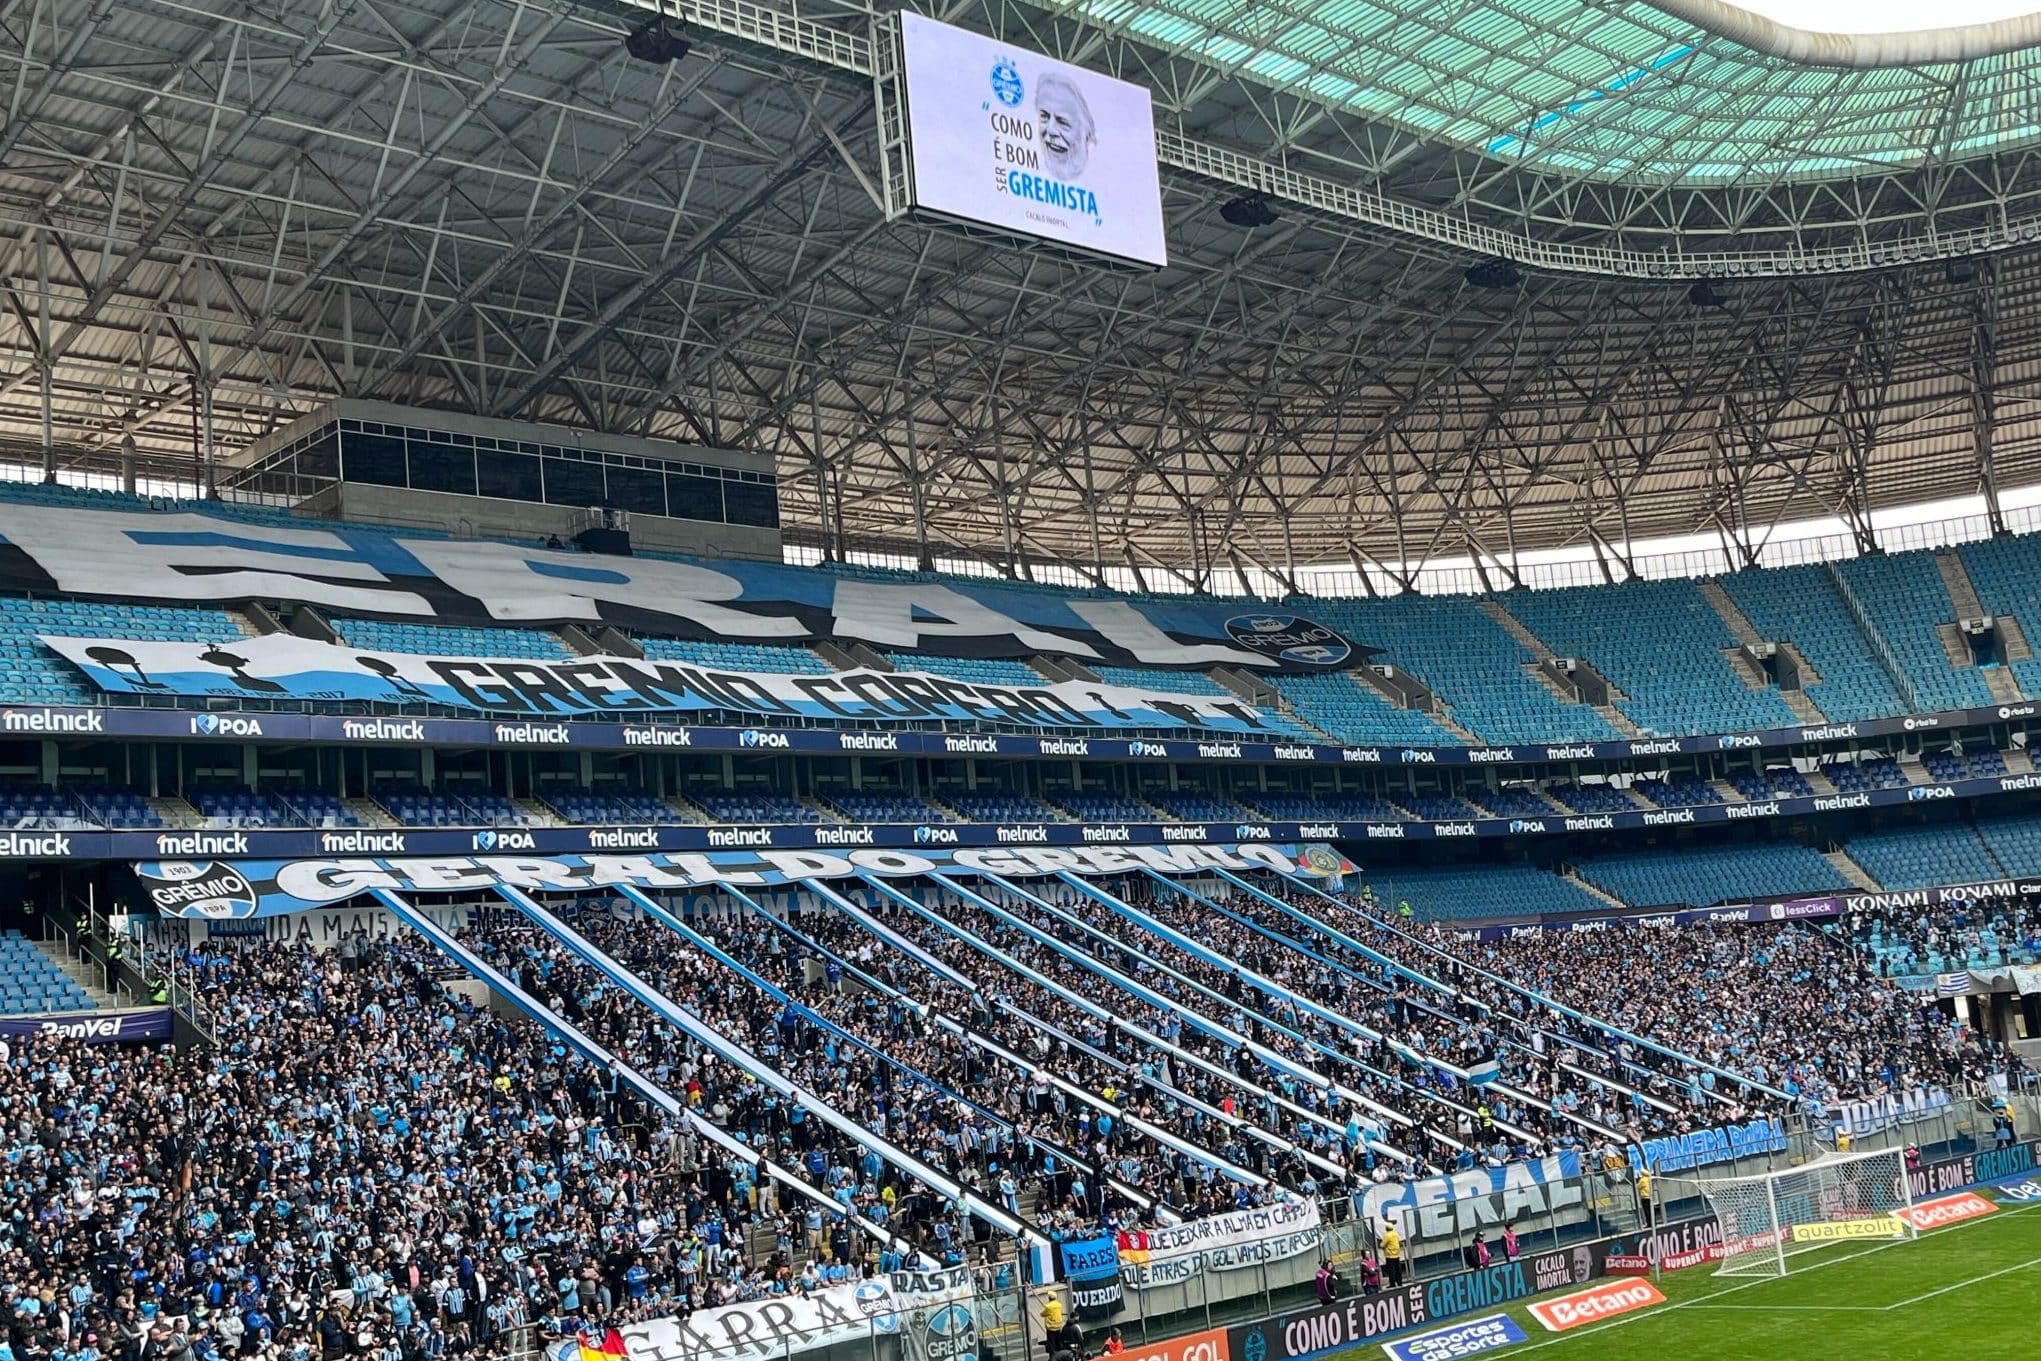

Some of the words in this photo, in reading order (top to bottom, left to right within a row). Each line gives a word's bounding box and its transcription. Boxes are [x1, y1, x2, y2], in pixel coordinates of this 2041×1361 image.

[991, 113, 1033, 141] COMO
[993, 137, 1001, 160] É
[1006, 148, 1040, 171] BOM
[995, 166, 1008, 194] SER
[1008, 170, 1099, 217] GREMISTA
[792, 675, 1102, 725] COPERO
[3, 708, 103, 732] melnick
[219, 719, 262, 735] POA
[342, 719, 424, 740] melnick
[495, 724, 570, 744] melnick
[623, 727, 691, 746] melnick
[1801, 723, 1857, 741] melnick
[760, 733, 790, 748] POA
[840, 733, 898, 750] melnick
[945, 735, 998, 753] melnick
[1039, 738, 1089, 756] melnick
[1629, 740, 1681, 756] melnick
[1735, 735, 1762, 748] POA
[1144, 743, 1167, 757] POA
[1198, 743, 1242, 758] melnick
[1274, 745, 1315, 761] melnick
[1343, 747, 1381, 762] melnick
[1414, 751, 1436, 763] POA
[1468, 748, 1514, 763] melnick
[1546, 744, 1595, 761] melnick
[1926, 787, 1956, 799] POA
[1725, 802, 1780, 819] melnick
[1813, 794, 1871, 811] melnick
[1565, 815, 1614, 831] melnick
[1643, 809, 1695, 825] melnick
[815, 826, 874, 844] melnick
[930, 828, 959, 843] POA
[996, 825, 1048, 842] melnick
[1082, 825, 1130, 841] melnick
[1162, 825, 1207, 840] melnick
[1250, 827, 1271, 839] POA
[1299, 824, 1339, 839] melnick
[1367, 824, 1405, 839] melnick
[1434, 822, 1476, 837] melnick
[1523, 820, 1545, 833] POA
[156, 832, 249, 854] melnick
[321, 831, 405, 852] melnick
[499, 833, 536, 849] POA
[588, 828, 659, 848] melnick
[707, 827, 772, 846] melnick
[276, 853, 768, 902] GERAL
[755, 849, 937, 883] DO
[151, 875, 243, 904] GRÊMIO
[1939, 882, 2017, 901] KONAMI
[1847, 891, 1929, 913] KONAMI
[322, 911, 388, 941] MAIS
[1928, 1164, 1936, 1193] É
[1938, 1163, 1964, 1191] BOM
[1964, 1156, 1975, 1184] SER
[1975, 1145, 2034, 1181] GREMISTA
[1363, 1151, 1583, 1241] GERAL
[1911, 1198, 1988, 1226] Betano
[1171, 1222, 1214, 1249] DEIXAR
[1254, 1211, 1272, 1229] EM
[1798, 1219, 1897, 1240] quartzolit
[1212, 1248, 1235, 1268] GOL
[1535, 1253, 1566, 1275] CACALO
[1605, 1258, 1648, 1269] Betano
[1665, 1250, 1705, 1269] SUPERBET
[890, 1264, 969, 1293] RASTA
[1536, 1268, 1572, 1291] IMORTAL
[1285, 1317, 1342, 1357] COMO
[1346, 1300, 1360, 1341] É
[1363, 1295, 1407, 1336] BOM
[1409, 1284, 1425, 1324] SER
[1427, 1261, 1528, 1319] GREMISTA
[1549, 1285, 1653, 1325] Betano
[622, 1293, 867, 1361] GARRA
[1408, 1320, 1505, 1355] Esportes
